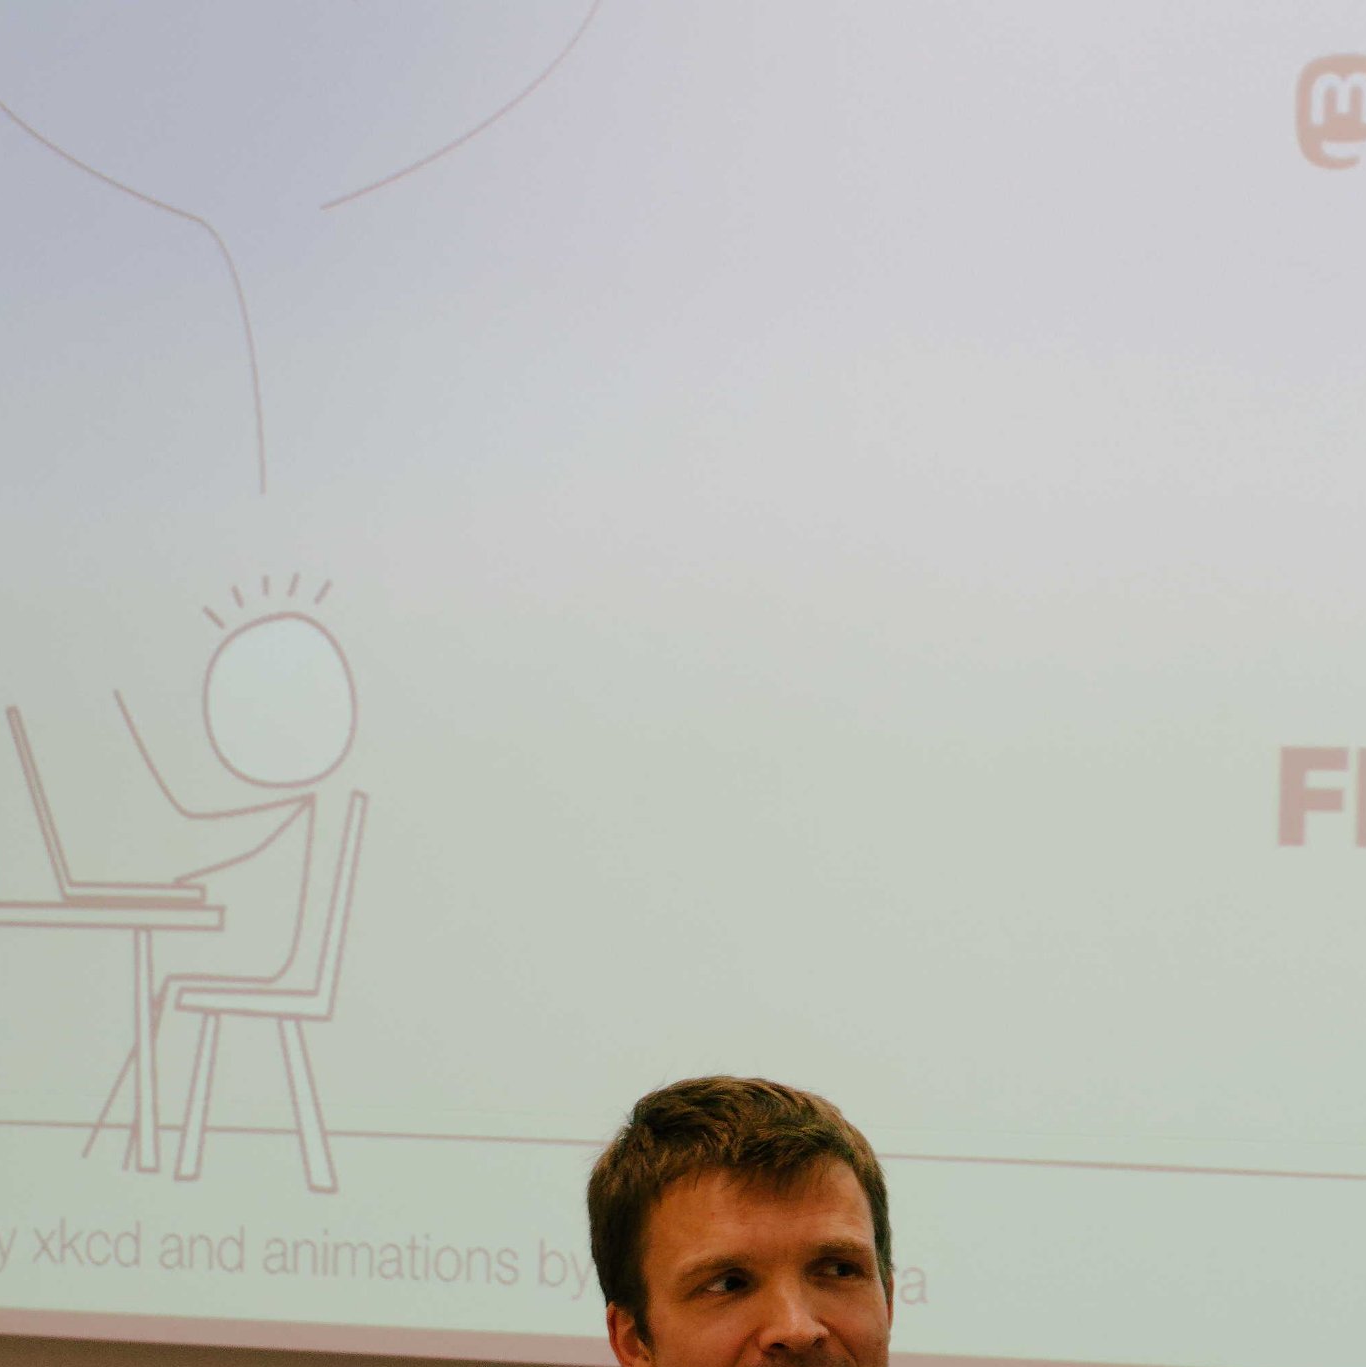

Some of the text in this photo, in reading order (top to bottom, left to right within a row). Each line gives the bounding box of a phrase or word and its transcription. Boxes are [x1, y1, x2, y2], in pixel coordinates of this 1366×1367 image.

[33, 1216, 143, 1268] xkcd
[157, 1225, 246, 1275] and
[261, 1228, 521, 1287] animations
[537, 1238, 594, 1301] by
